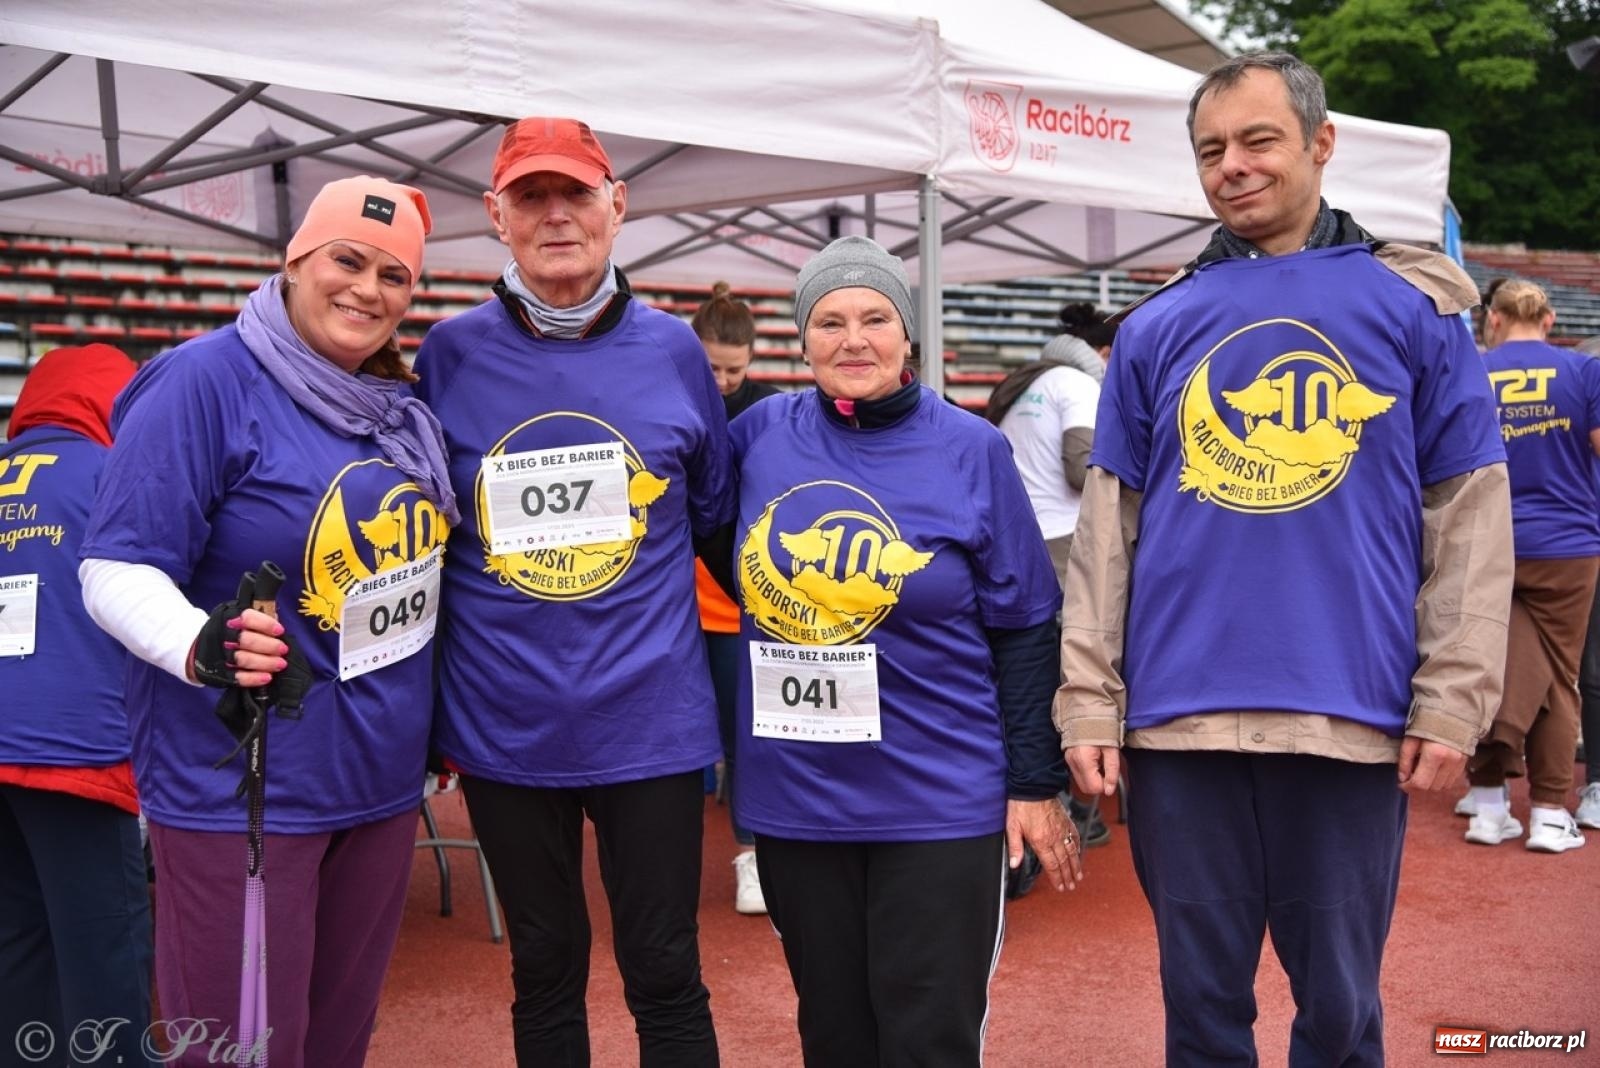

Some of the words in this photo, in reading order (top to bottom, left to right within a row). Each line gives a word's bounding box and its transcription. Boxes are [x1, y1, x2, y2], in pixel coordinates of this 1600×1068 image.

[1270, 371, 1339, 430] 10
[1505, 405, 1556, 419] SYSTEM
[507, 457, 537, 471] BIEG
[541, 454, 566, 466] BEZ
[569, 449, 615, 463] BARIER
[1192, 419, 1276, 484] RACIBORSKI
[520, 479, 594, 517] 037
[1228, 483, 1253, 500] BIEG
[1256, 488, 1277, 501] BEZ
[1280, 473, 1321, 499] BARIER
[393, 500, 437, 561] 10
[820, 525, 882, 582] 10
[362, 577, 387, 593] BIEG
[390, 569, 409, 584] BEZ
[529, 571, 554, 589] BIEG
[557, 576, 577, 589] BEZ
[579, 560, 616, 586] BARIER
[745, 552, 817, 626] RACIBORSKI
[369, 589, 426, 636] 049
[779, 619, 799, 638] BIEG
[801, 628, 819, 641] BEZ
[771, 649, 796, 660] BIEG
[798, 651, 819, 661] BEZ
[822, 652, 866, 662] BARIER
[781, 676, 838, 710] 041
